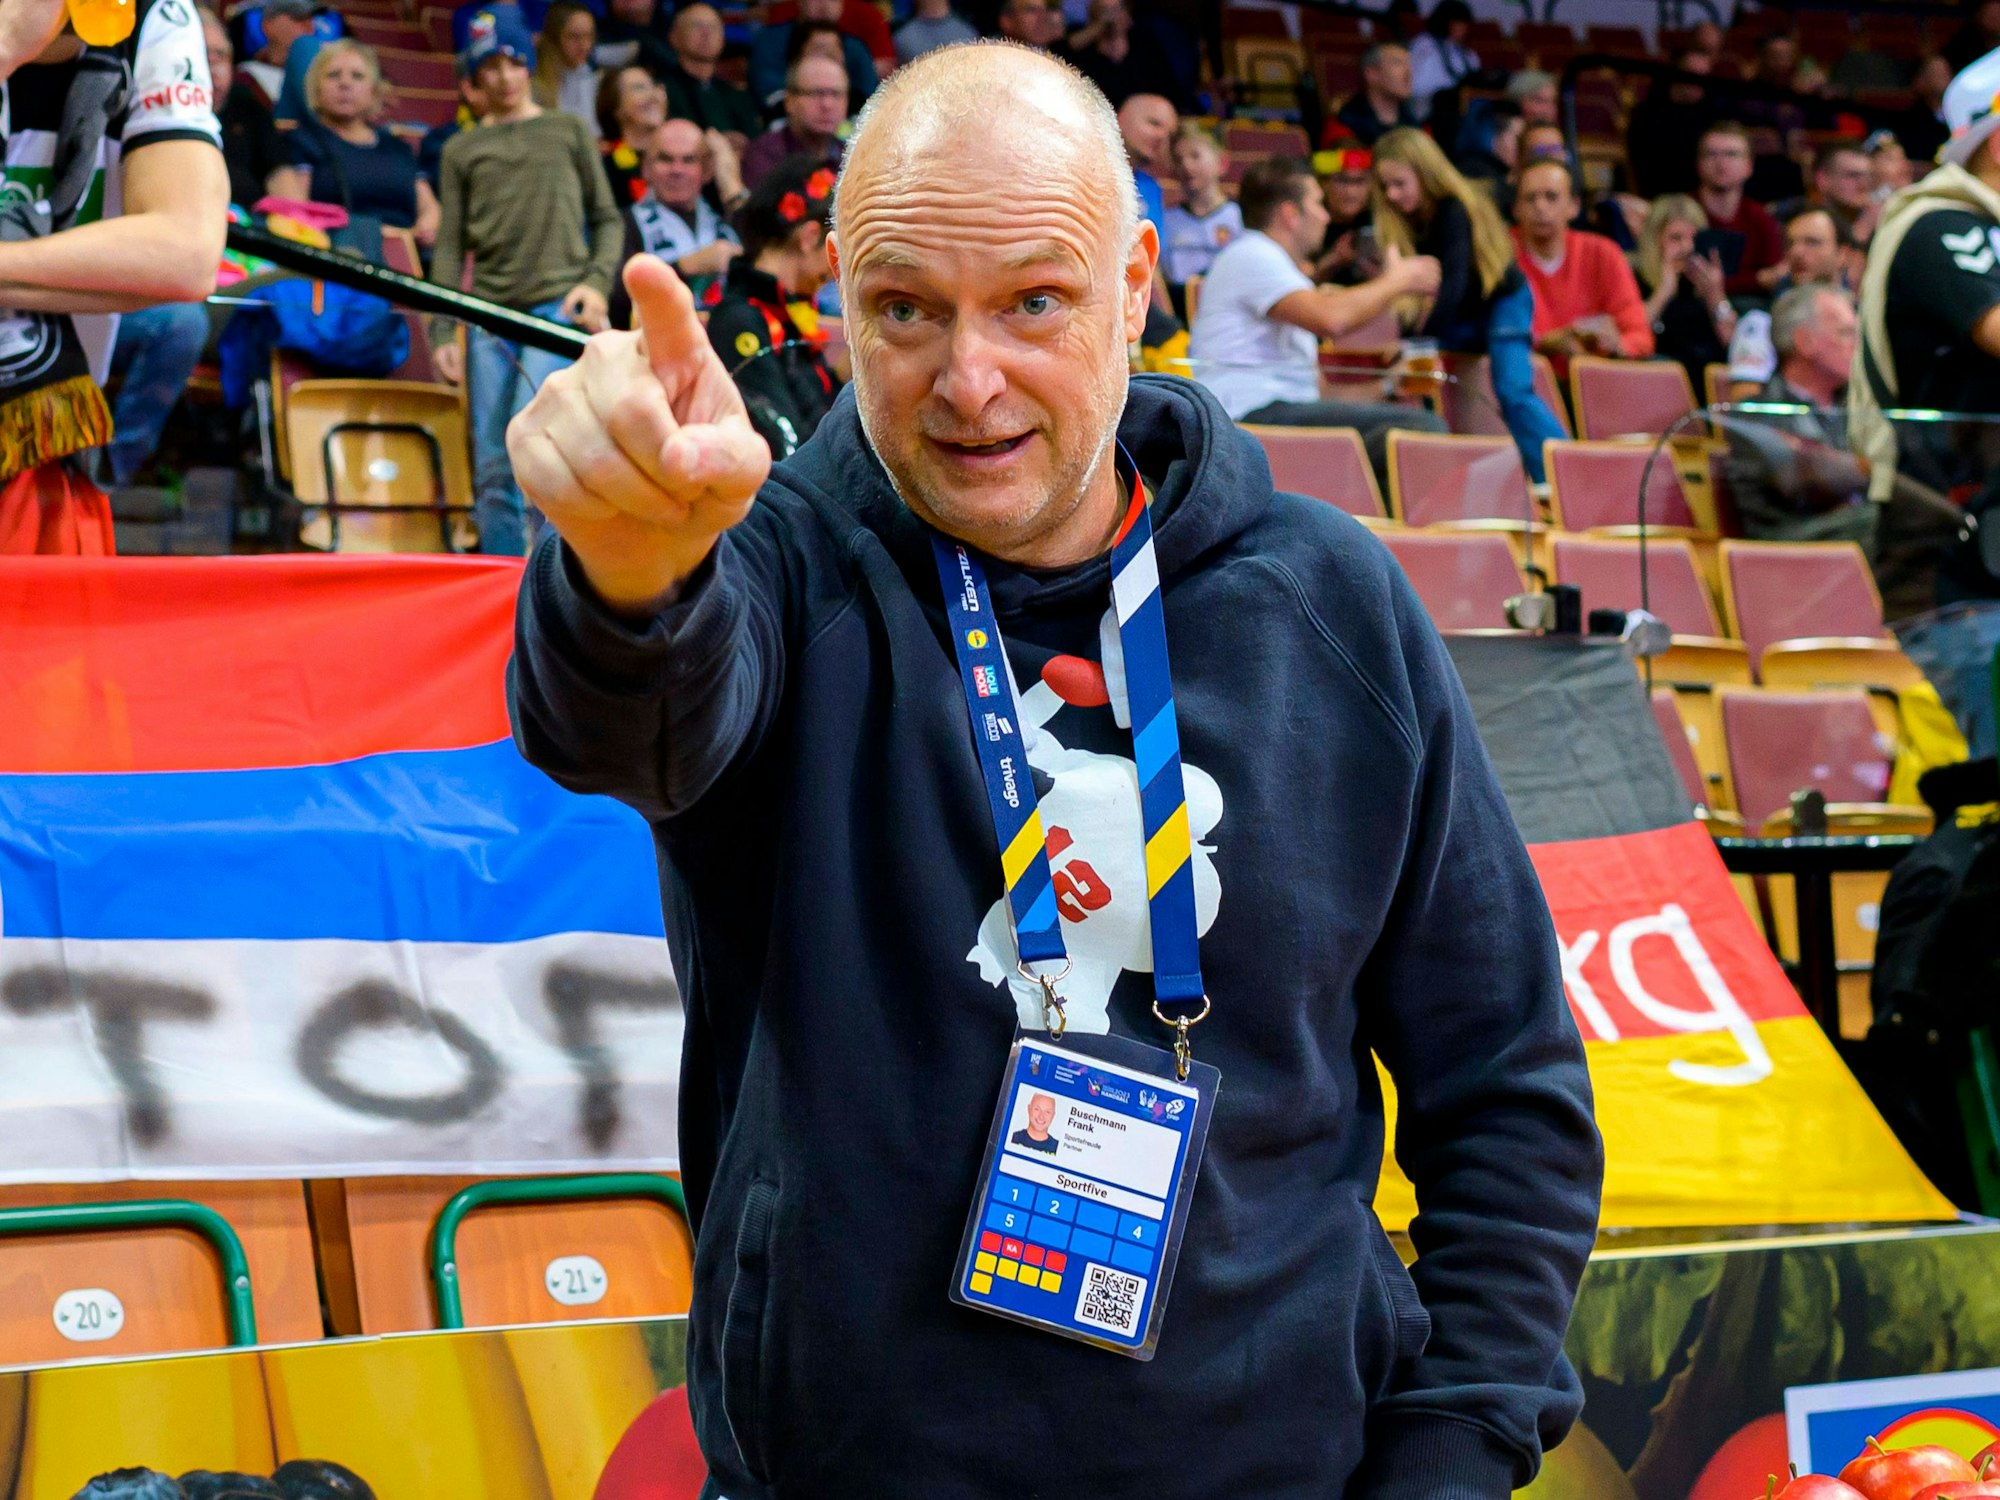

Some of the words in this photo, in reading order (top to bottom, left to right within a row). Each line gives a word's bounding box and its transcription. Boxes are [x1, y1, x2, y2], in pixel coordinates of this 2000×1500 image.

[143, 83, 213, 112] NIGA
[975, 666, 990, 697] MOLY
[1000, 756, 1020, 808] trivago
[1067, 1117, 1095, 1134] Frank
[1070, 1106, 1127, 1132] Buschmann
[1011, 1188, 1019, 1202] 1
[1056, 1174, 1108, 1199] Sportfive
[1049, 1200, 1061, 1215] 2
[1004, 1213, 1015, 1228] 5
[1132, 1225, 1142, 1240] 4
[1006, 1243, 1018, 1254] KA
[564, 1268, 588, 1294] 21
[76, 1302, 101, 1330] 20
